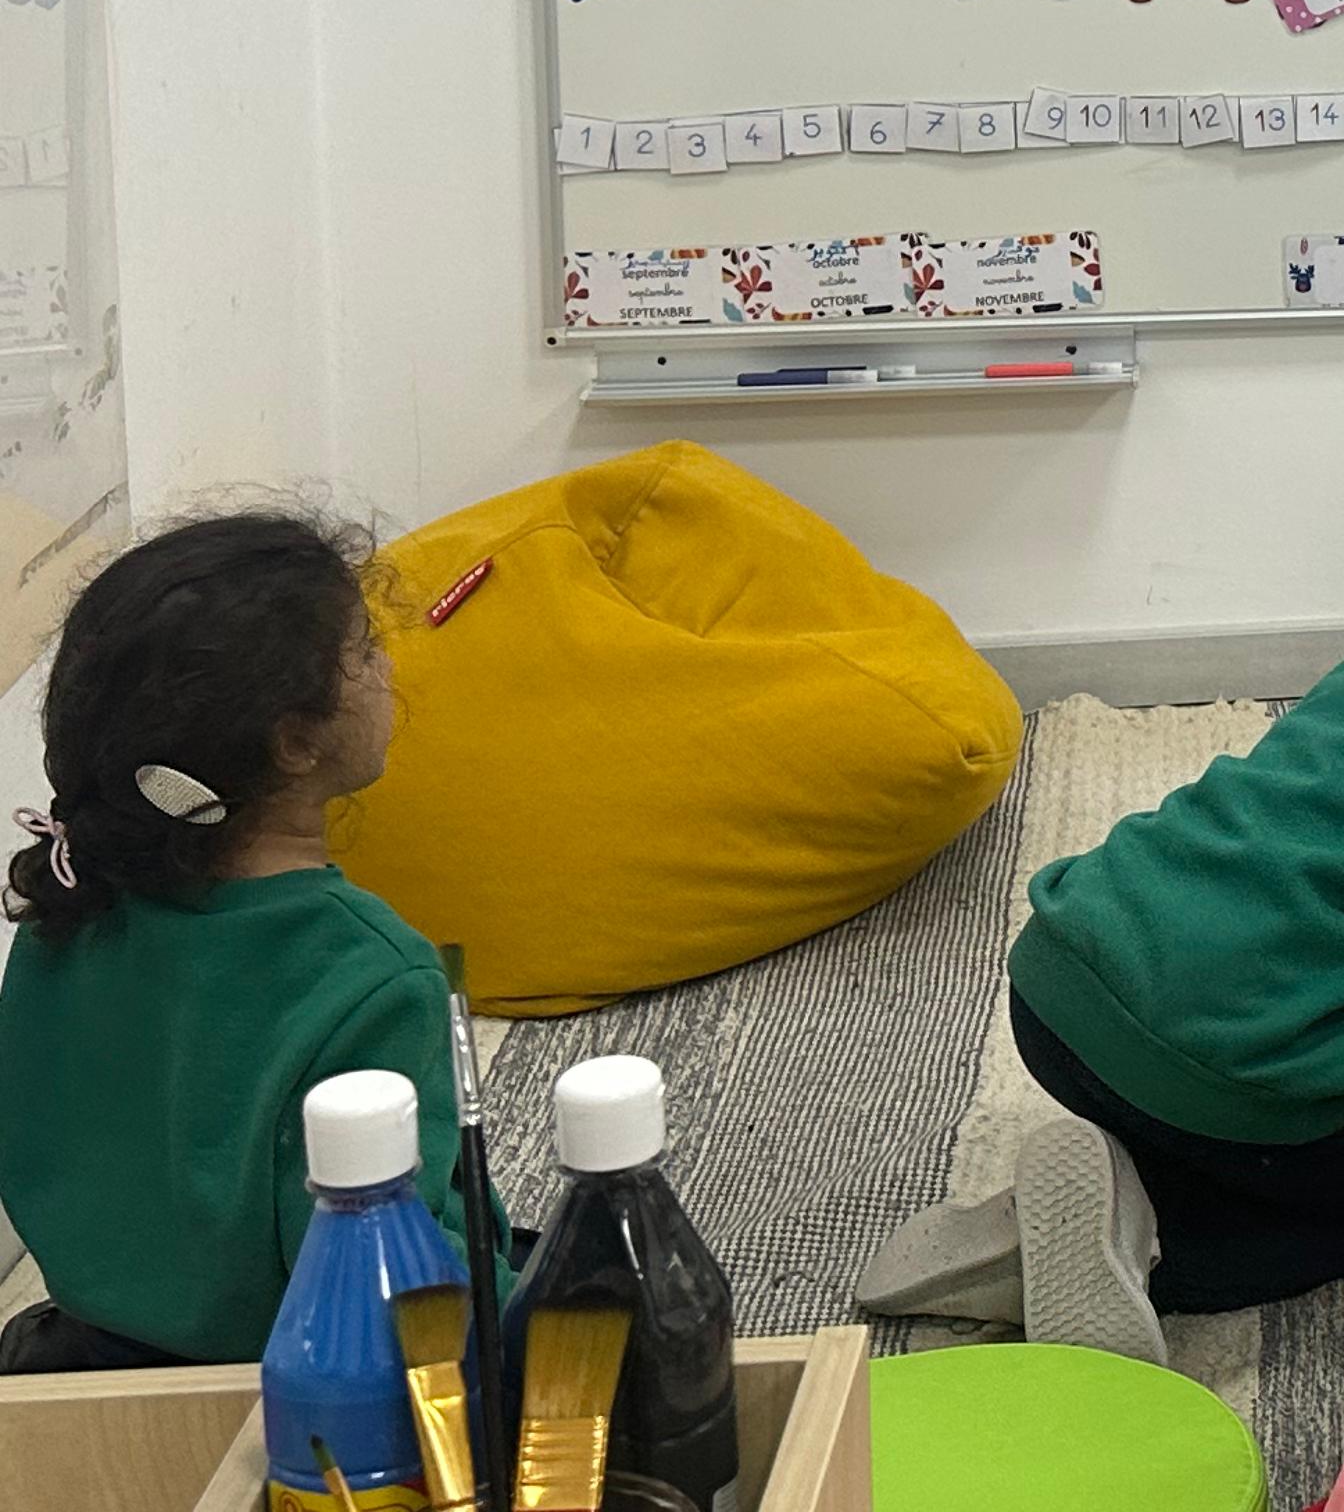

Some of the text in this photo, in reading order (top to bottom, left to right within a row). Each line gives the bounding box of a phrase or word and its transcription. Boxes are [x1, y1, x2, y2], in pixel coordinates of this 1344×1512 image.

[581, 127, 591, 150] 1
[636, 130, 653, 154] 2
[689, 134, 706, 157] 3
[744, 124, 763, 147] 4
[802, 114, 821, 137] 5
[870, 121, 887, 143] 6
[926, 112, 943, 135] 7
[978, 113, 995, 137] 8
[1048, 106, 1063, 128] 9
[1079, 103, 1112, 128] 10
[1140, 105, 1167, 128] 11
[1189, 104, 1221, 131] 12
[1255, 107, 1287, 132] 13
[1311, 103, 1340, 126] 14
[811, 293, 868, 309] OCTOBRE
[976, 291, 1045, 306] NOVEMBRE
[619, 306, 693, 320] SEPTEMBRE
